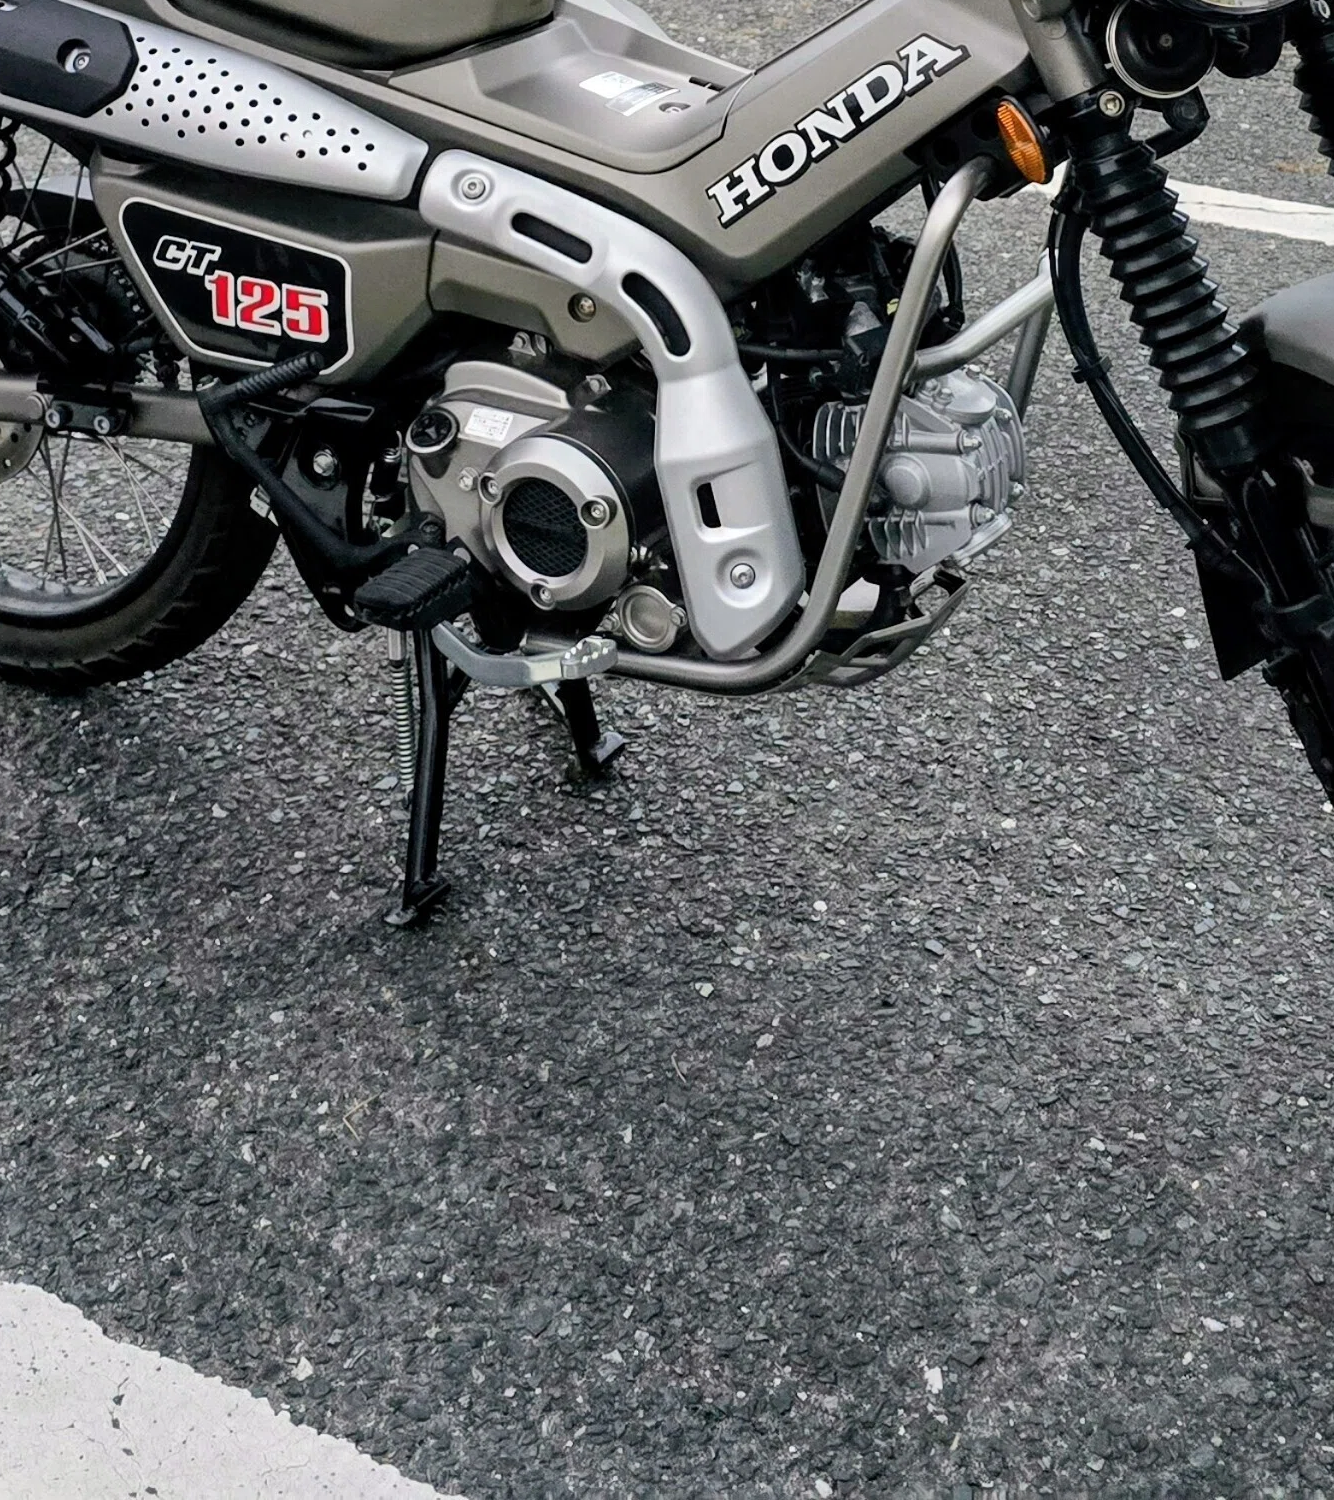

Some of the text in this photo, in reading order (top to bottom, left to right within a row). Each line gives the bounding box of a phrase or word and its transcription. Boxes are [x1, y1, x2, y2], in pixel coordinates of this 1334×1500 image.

[706, 33, 969, 227] HONDA
[153, 235, 221, 276] CT
[204, 269, 329, 343] 125
